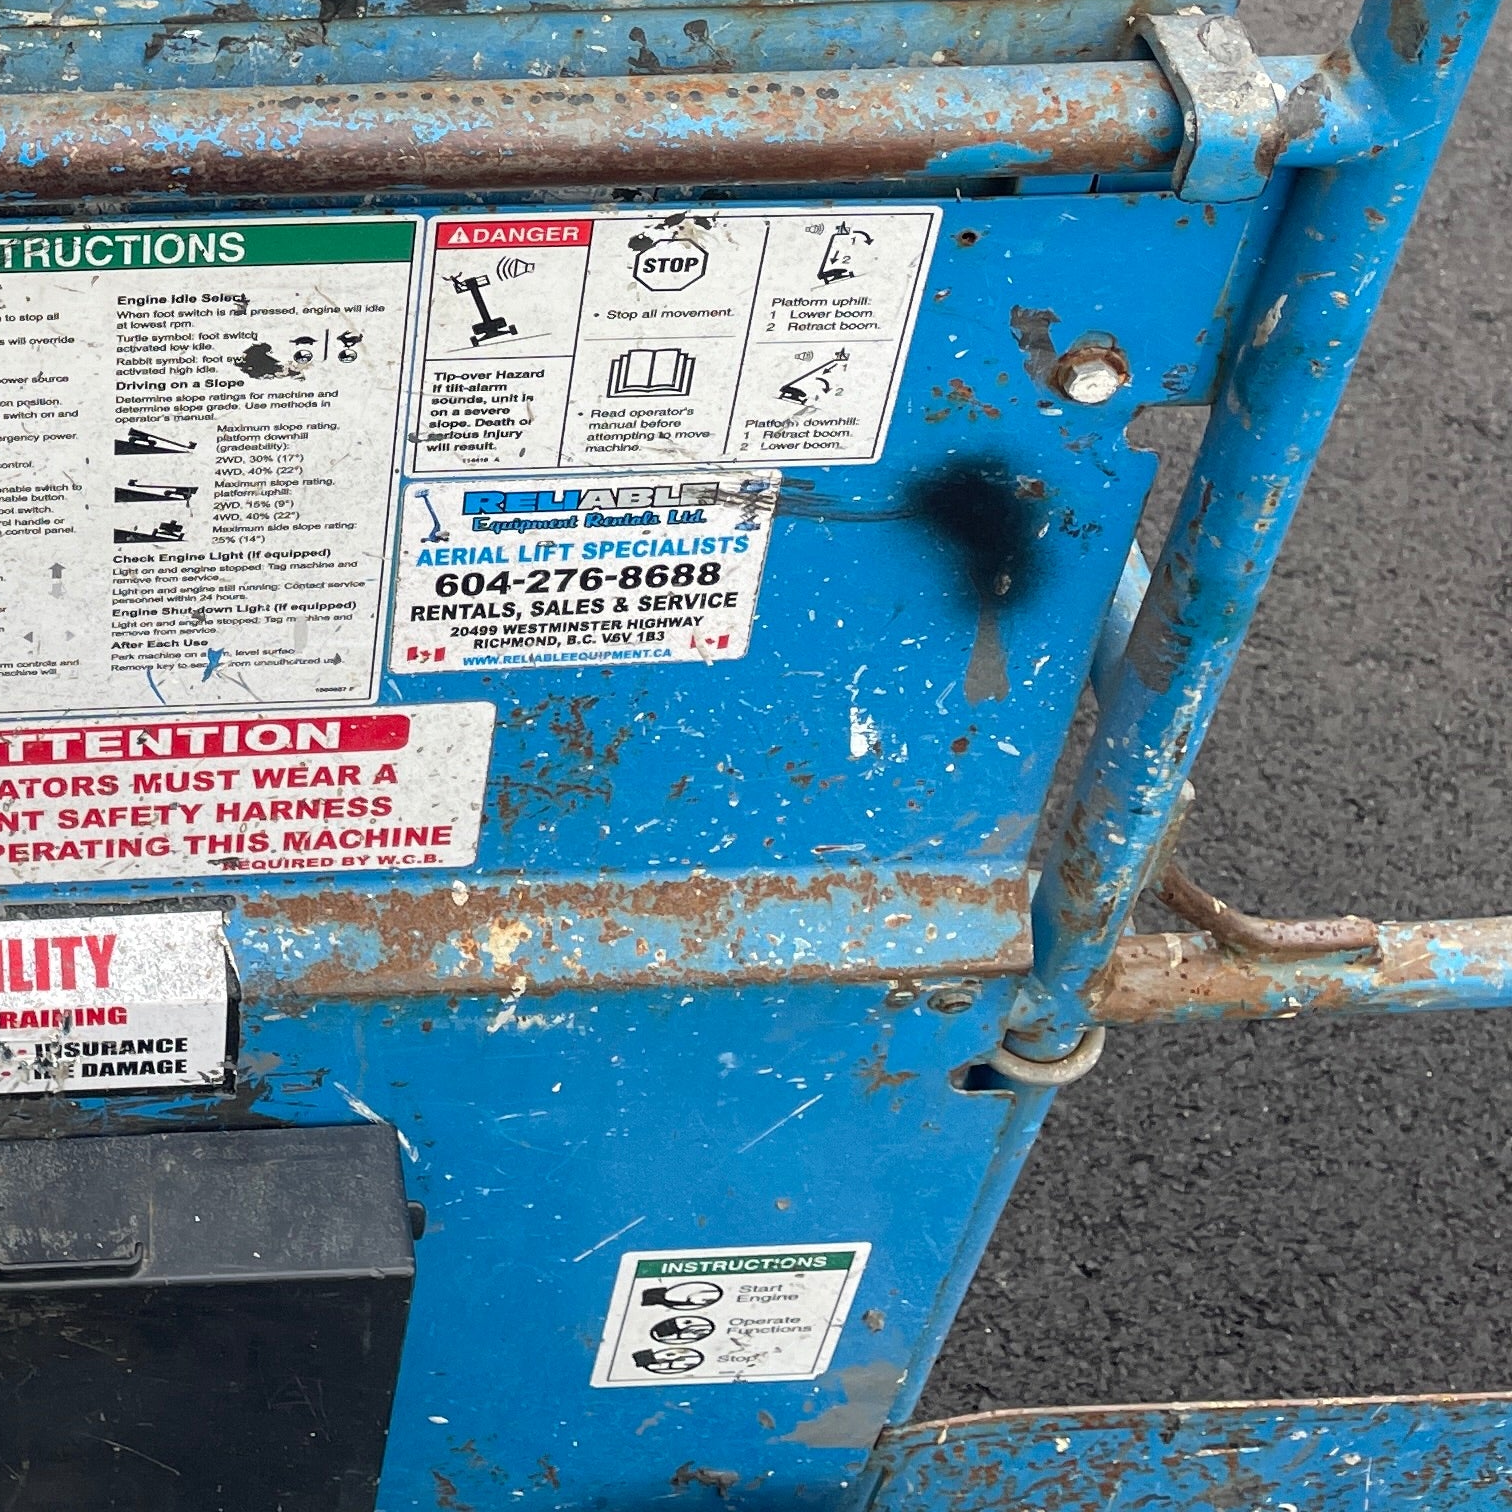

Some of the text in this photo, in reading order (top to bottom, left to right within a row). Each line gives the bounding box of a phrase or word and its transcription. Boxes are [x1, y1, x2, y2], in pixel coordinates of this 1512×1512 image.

[473, 227, 580, 244] DANGER
[643, 257, 699, 274] STOP
[117, 295, 167, 306] Engine
[171, 294, 197, 304] Idle
[772, 296, 872, 308] Platform uphill:
[607, 307, 735, 321] Stop all movement.
[790, 310, 832, 320] Lower
[788, 321, 881, 332] Retract boom.
[115, 377, 245, 391] Driving on a Slope
[434, 369, 545, 382] Tip-over Hazard
[462, 482, 720, 515] RELIABLE
[472, 509, 707, 534] Equipment Rentals Ltd.
[416, 535, 750, 567] AERIAL LIFT SPECIALISTS
[435, 562, 722, 598] 604-276-8688
[411, 591, 739, 622] RENTALS, SALES & SERVICE
[450, 615, 705, 637] 20499 WESTMINSTER HIGHWAY
[473, 631, 666, 650] RICHMOND, B.C. V6V 1B3
[462, 647, 672, 666] WWW.RELIABLEEQUIPMENT.CA
[133, 768, 240, 795] MUST
[252, 764, 362, 789] WEAR
[372, 762, 398, 785] A
[57, 803, 203, 830] SAFETY
[215, 795, 393, 824] HARNESS
[183, 831, 270, 855] THIS
[283, 825, 453, 852] MACHINE
[221, 853, 443, 872] REQUIRED BY W.C.B.
[34, 1037, 188, 1059] INSURANCE
[81, 1059, 188, 1079] DAMAGE
[661, 1256, 828, 1274] INSTRUCTIONS
[737, 1292, 799, 1303] Engine
[739, 1284, 784, 1293] Start
[726, 1324, 813, 1335] Functions
[729, 1315, 801, 1326] Operate
[717, 1354, 756, 1364] Stop
